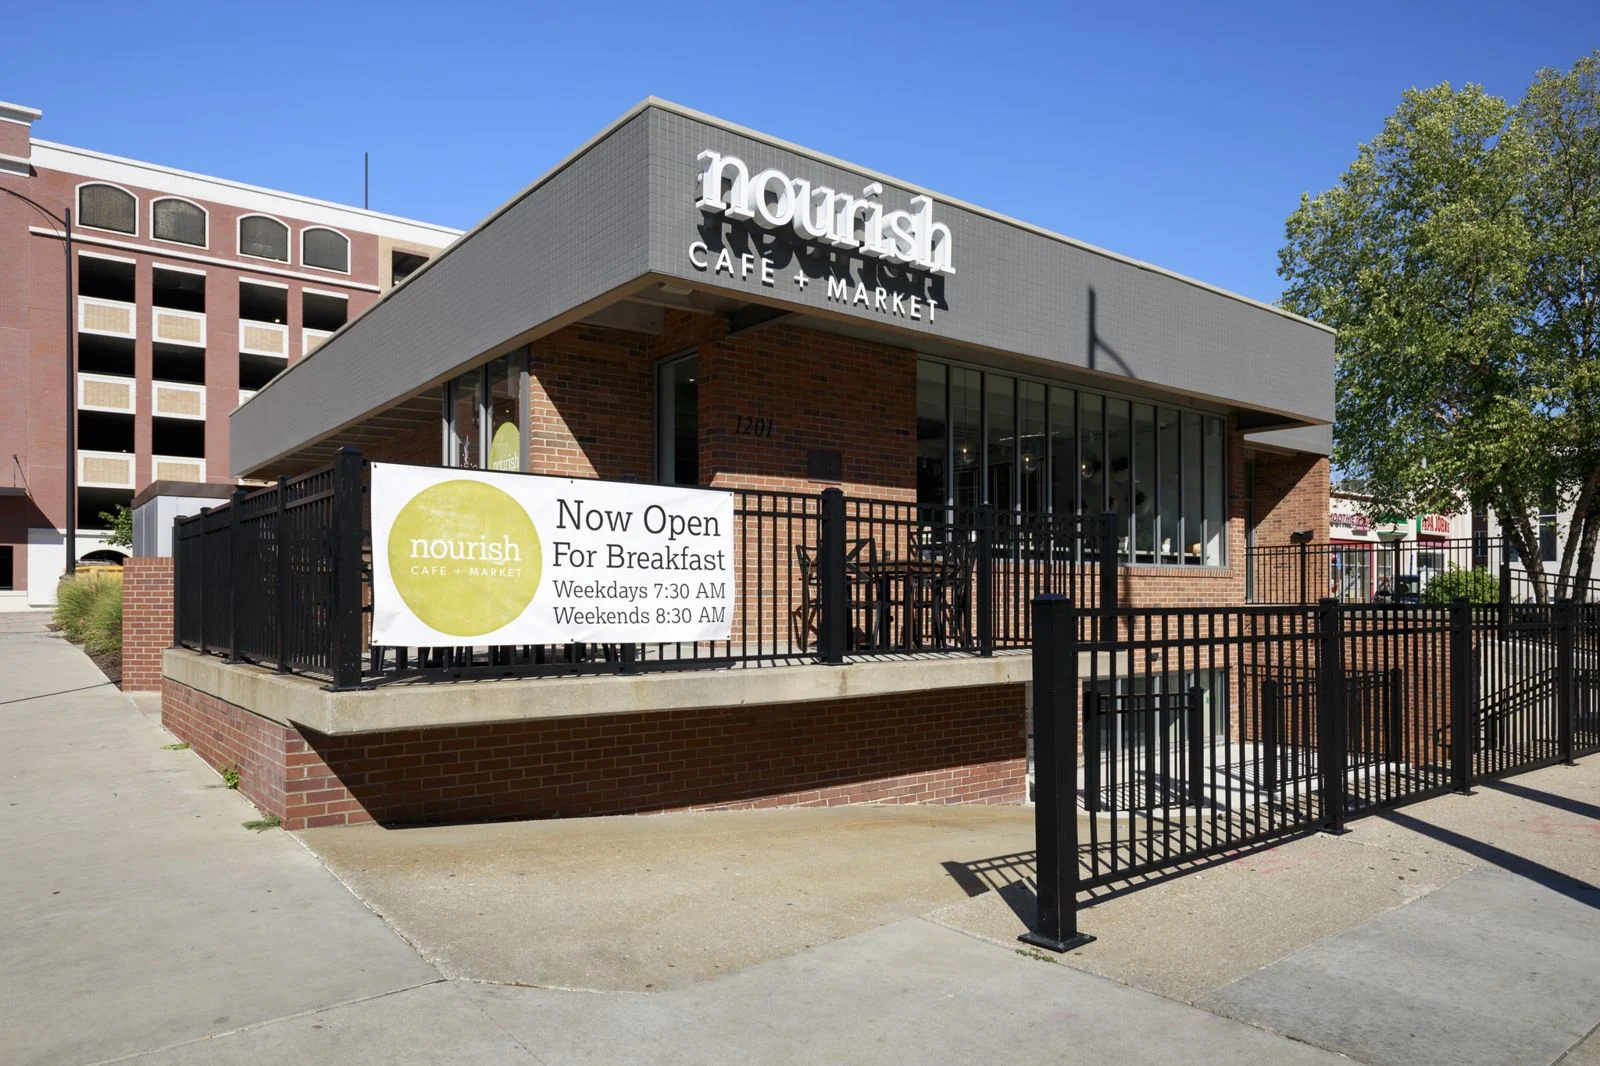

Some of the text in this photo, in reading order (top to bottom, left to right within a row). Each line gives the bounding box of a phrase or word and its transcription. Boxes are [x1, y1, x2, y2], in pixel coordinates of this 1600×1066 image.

[696, 149, 956, 274] nourish
[688, 241, 938, 322] CAFÉ + MARKET
[735, 415, 773, 439] 1201
[556, 498, 721, 541] Now Open
[410, 534, 521, 562] nourish
[552, 542, 726, 571] For Breakfast
[469, 567, 521, 577] MARKET
[552, 580, 726, 602] Weekdays 7:30 AM
[553, 606, 726, 625] Weekends 8:30 AM
